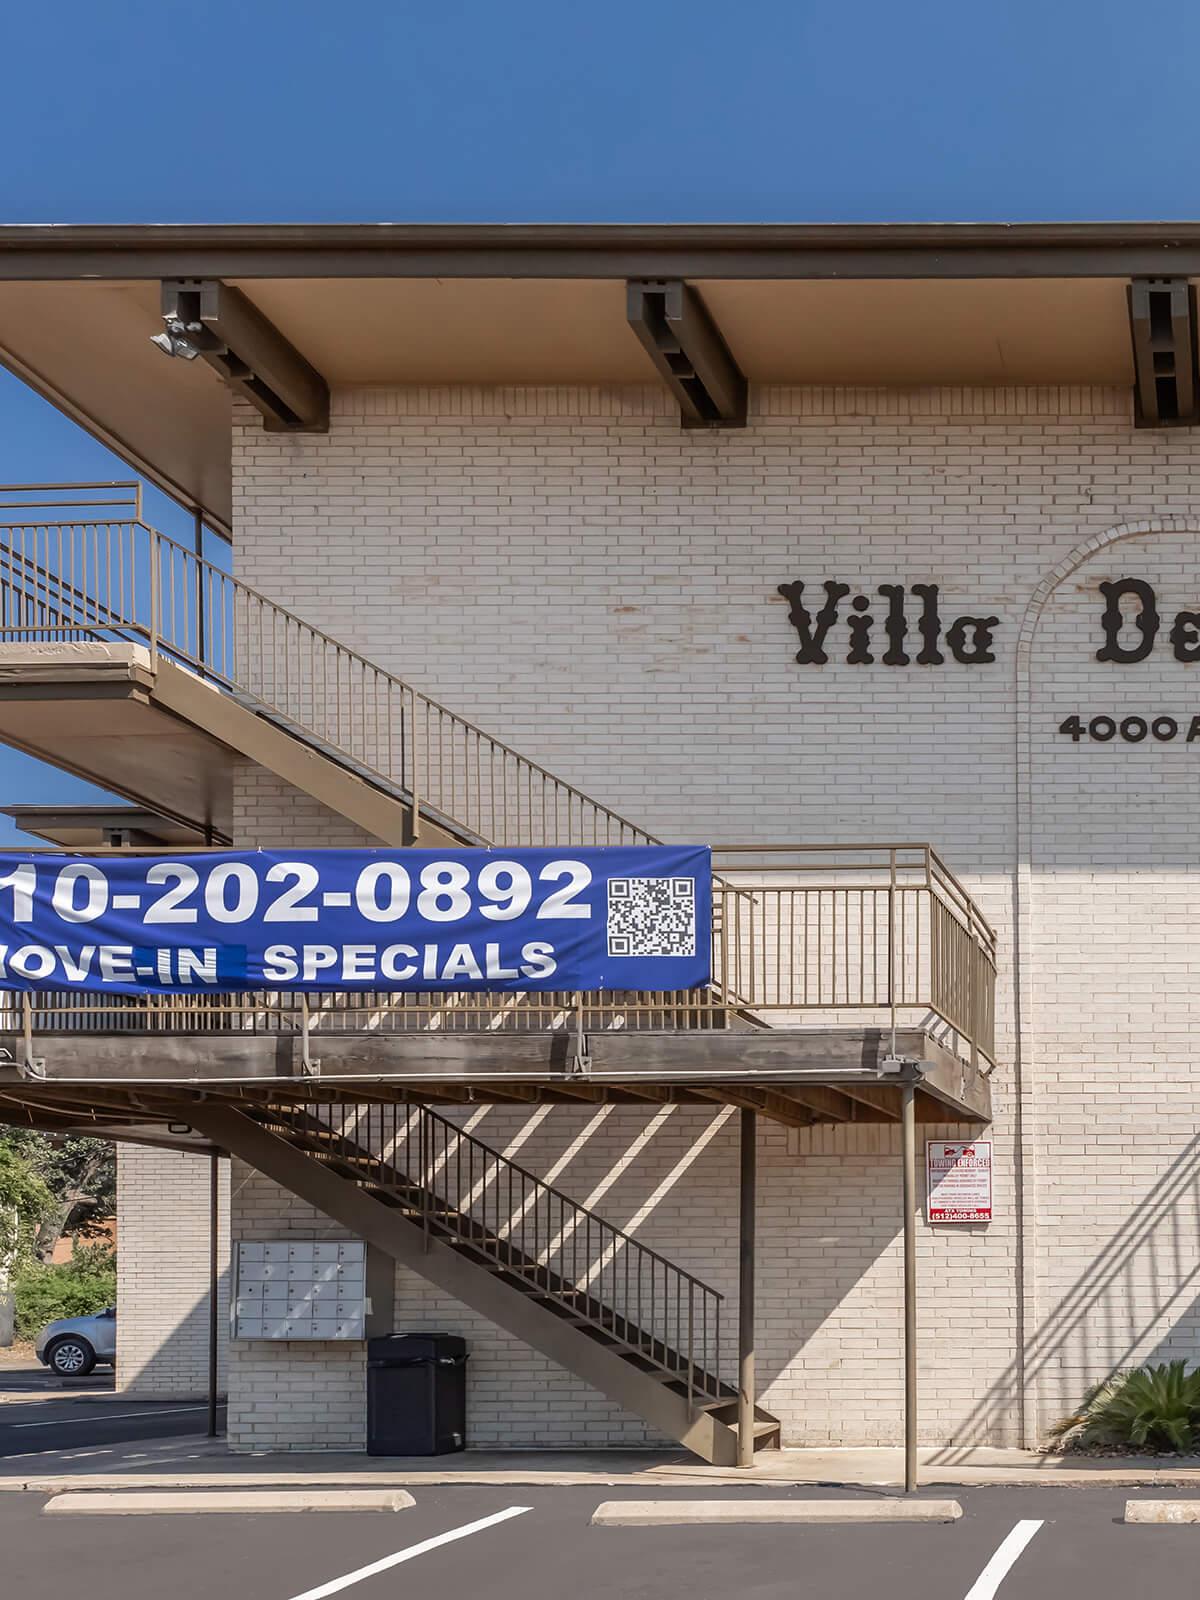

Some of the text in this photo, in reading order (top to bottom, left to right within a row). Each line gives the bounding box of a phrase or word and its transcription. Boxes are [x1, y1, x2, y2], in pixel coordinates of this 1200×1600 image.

[777, 579, 1000, 666] Villa
[1058, 715, 1178, 743] 4000
[262, 941, 557, 982] SPECIALS
